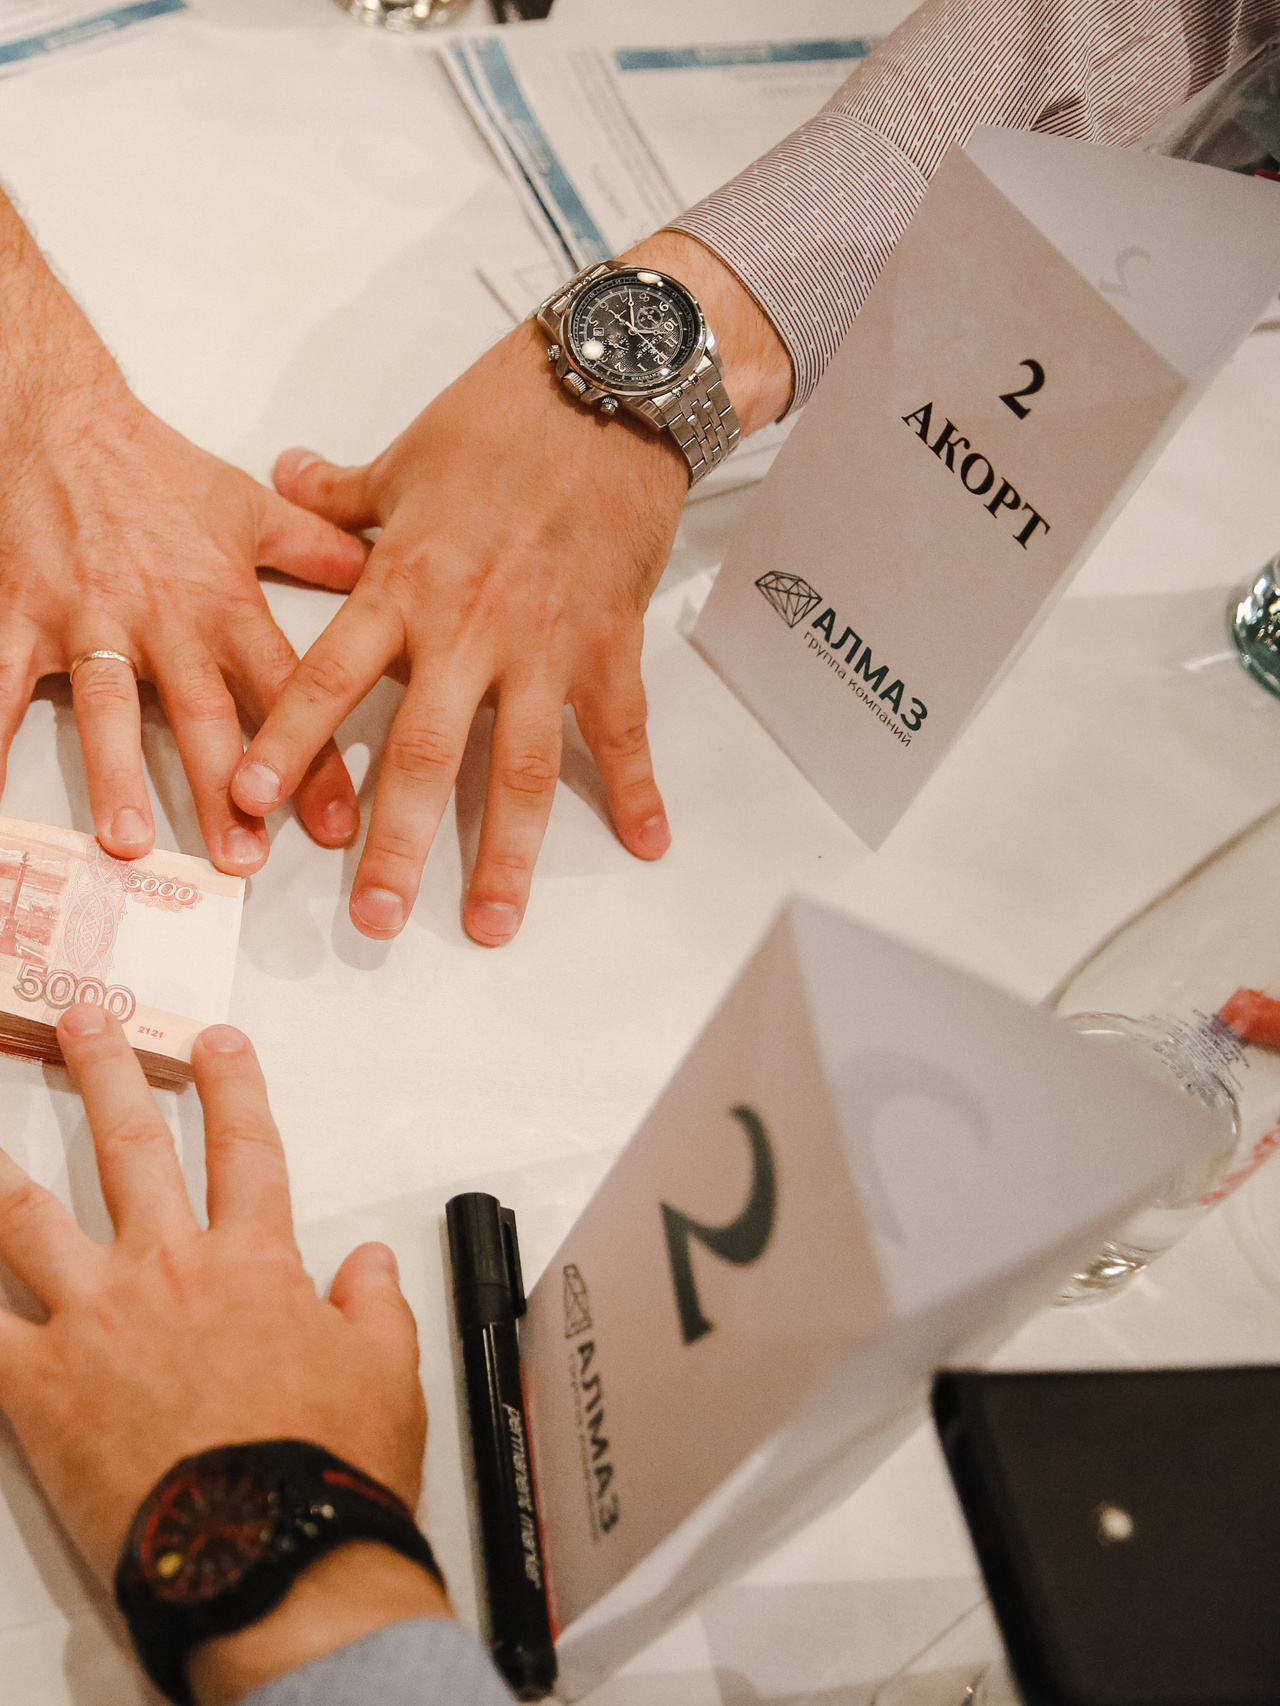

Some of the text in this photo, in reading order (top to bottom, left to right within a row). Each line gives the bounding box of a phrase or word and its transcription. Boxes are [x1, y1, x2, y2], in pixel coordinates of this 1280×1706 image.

[639, 292, 650, 302] 8
[659, 301, 669, 312] 9
[663, 317, 679, 332] 10
[664, 336, 679, 348] 11
[614, 362, 627, 373] 2
[637, 363, 647, 372] 1
[653, 351, 670, 365] 12
[999, 358, 1046, 420] 2
[901, 401, 1051, 550] АКОРТ
[811, 607, 928, 732] АЛМАЗ
[803, 631, 913, 748] группа компаний
[123, 873, 196, 903] 5000
[13, 962, 136, 1024] 5000
[137, 1025, 165, 1039] 2121
[660, 1103, 778, 1346] 2
[501, 1403, 541, 1589] permanent marker
